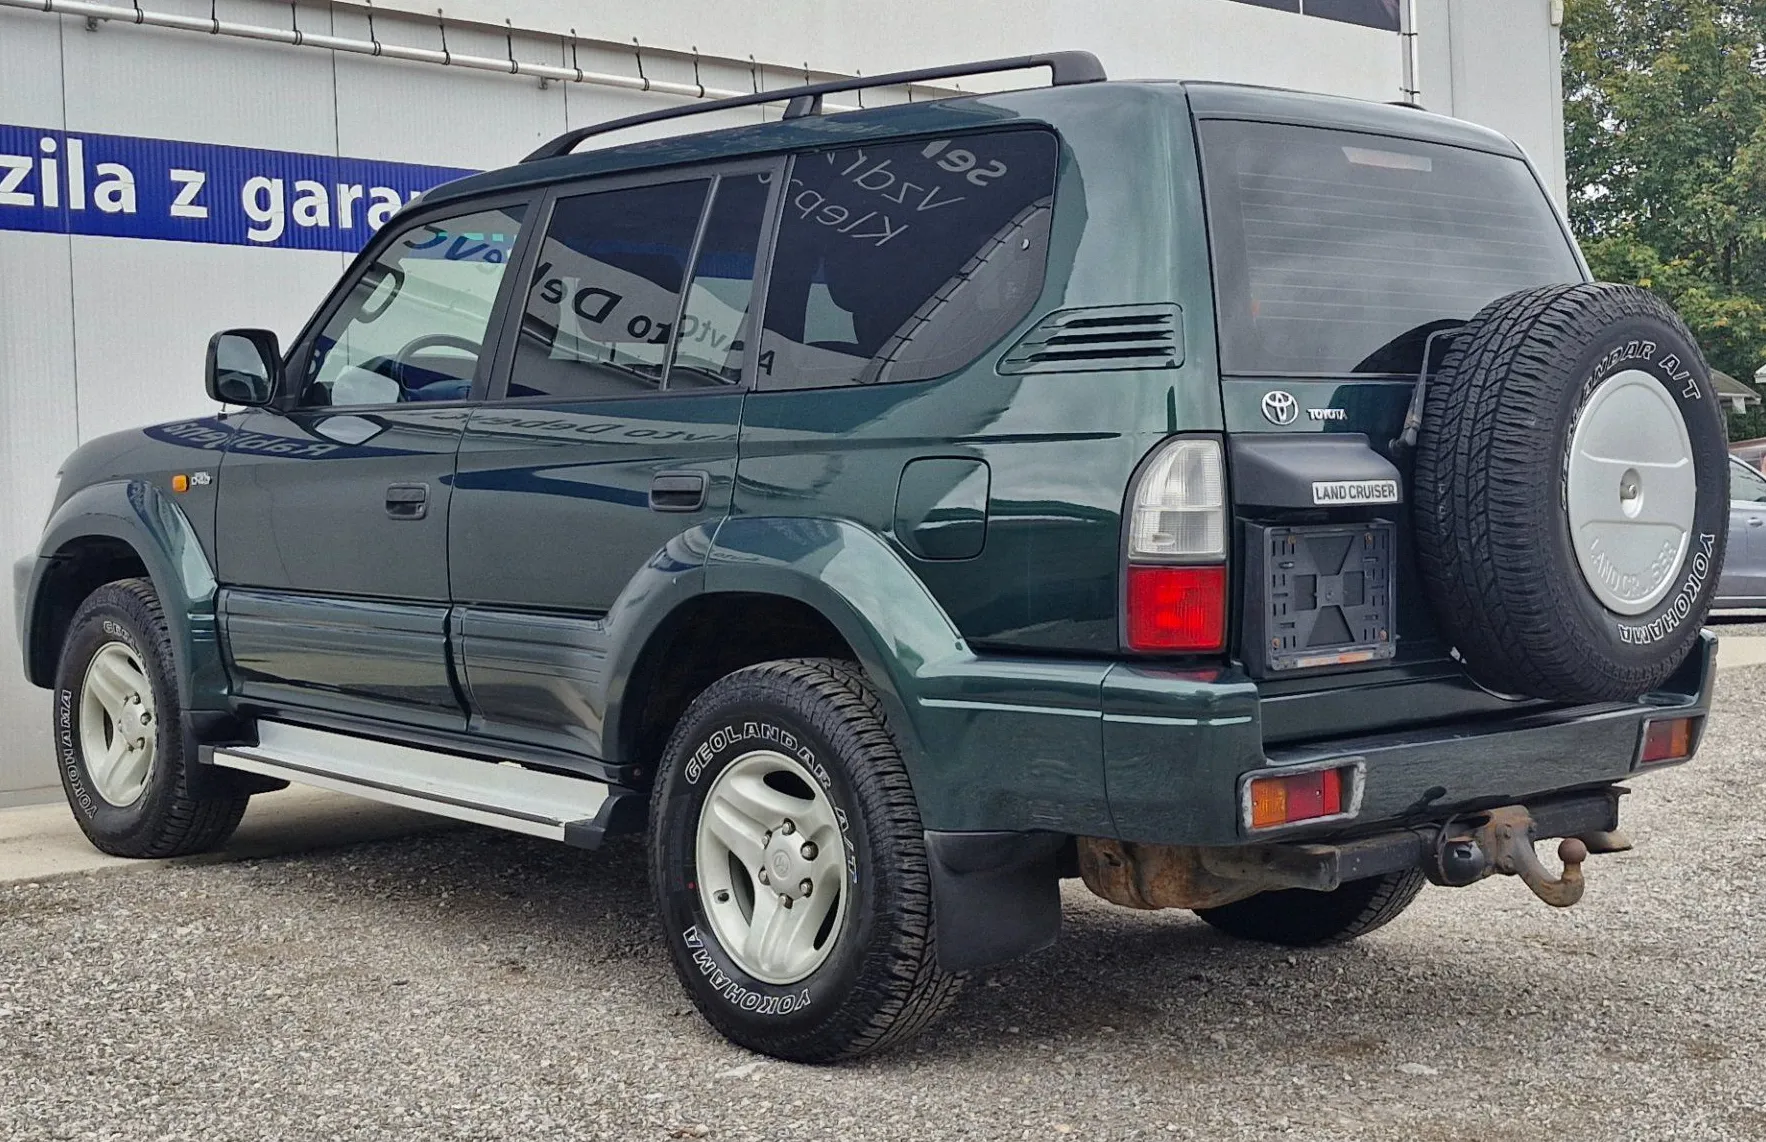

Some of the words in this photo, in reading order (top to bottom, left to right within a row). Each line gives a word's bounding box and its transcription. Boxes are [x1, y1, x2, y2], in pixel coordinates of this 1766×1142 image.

[0, 137, 137, 214] zila
[169, 169, 208, 218] z
[241, 176, 426, 242] gara
[1306, 408, 1348, 421] TOYOTA
[1658, 353, 1702, 400] A/T
[1315, 485, 1347, 501] LAND
[1349, 483, 1396, 500] CRUISER
[1617, 532, 1716, 645] YOKOHAMA
[60, 689, 99, 820] YOKOHAMA
[684, 722, 832, 790] GEOLANDAR
[682, 925, 812, 1016] YOKOHAMA
